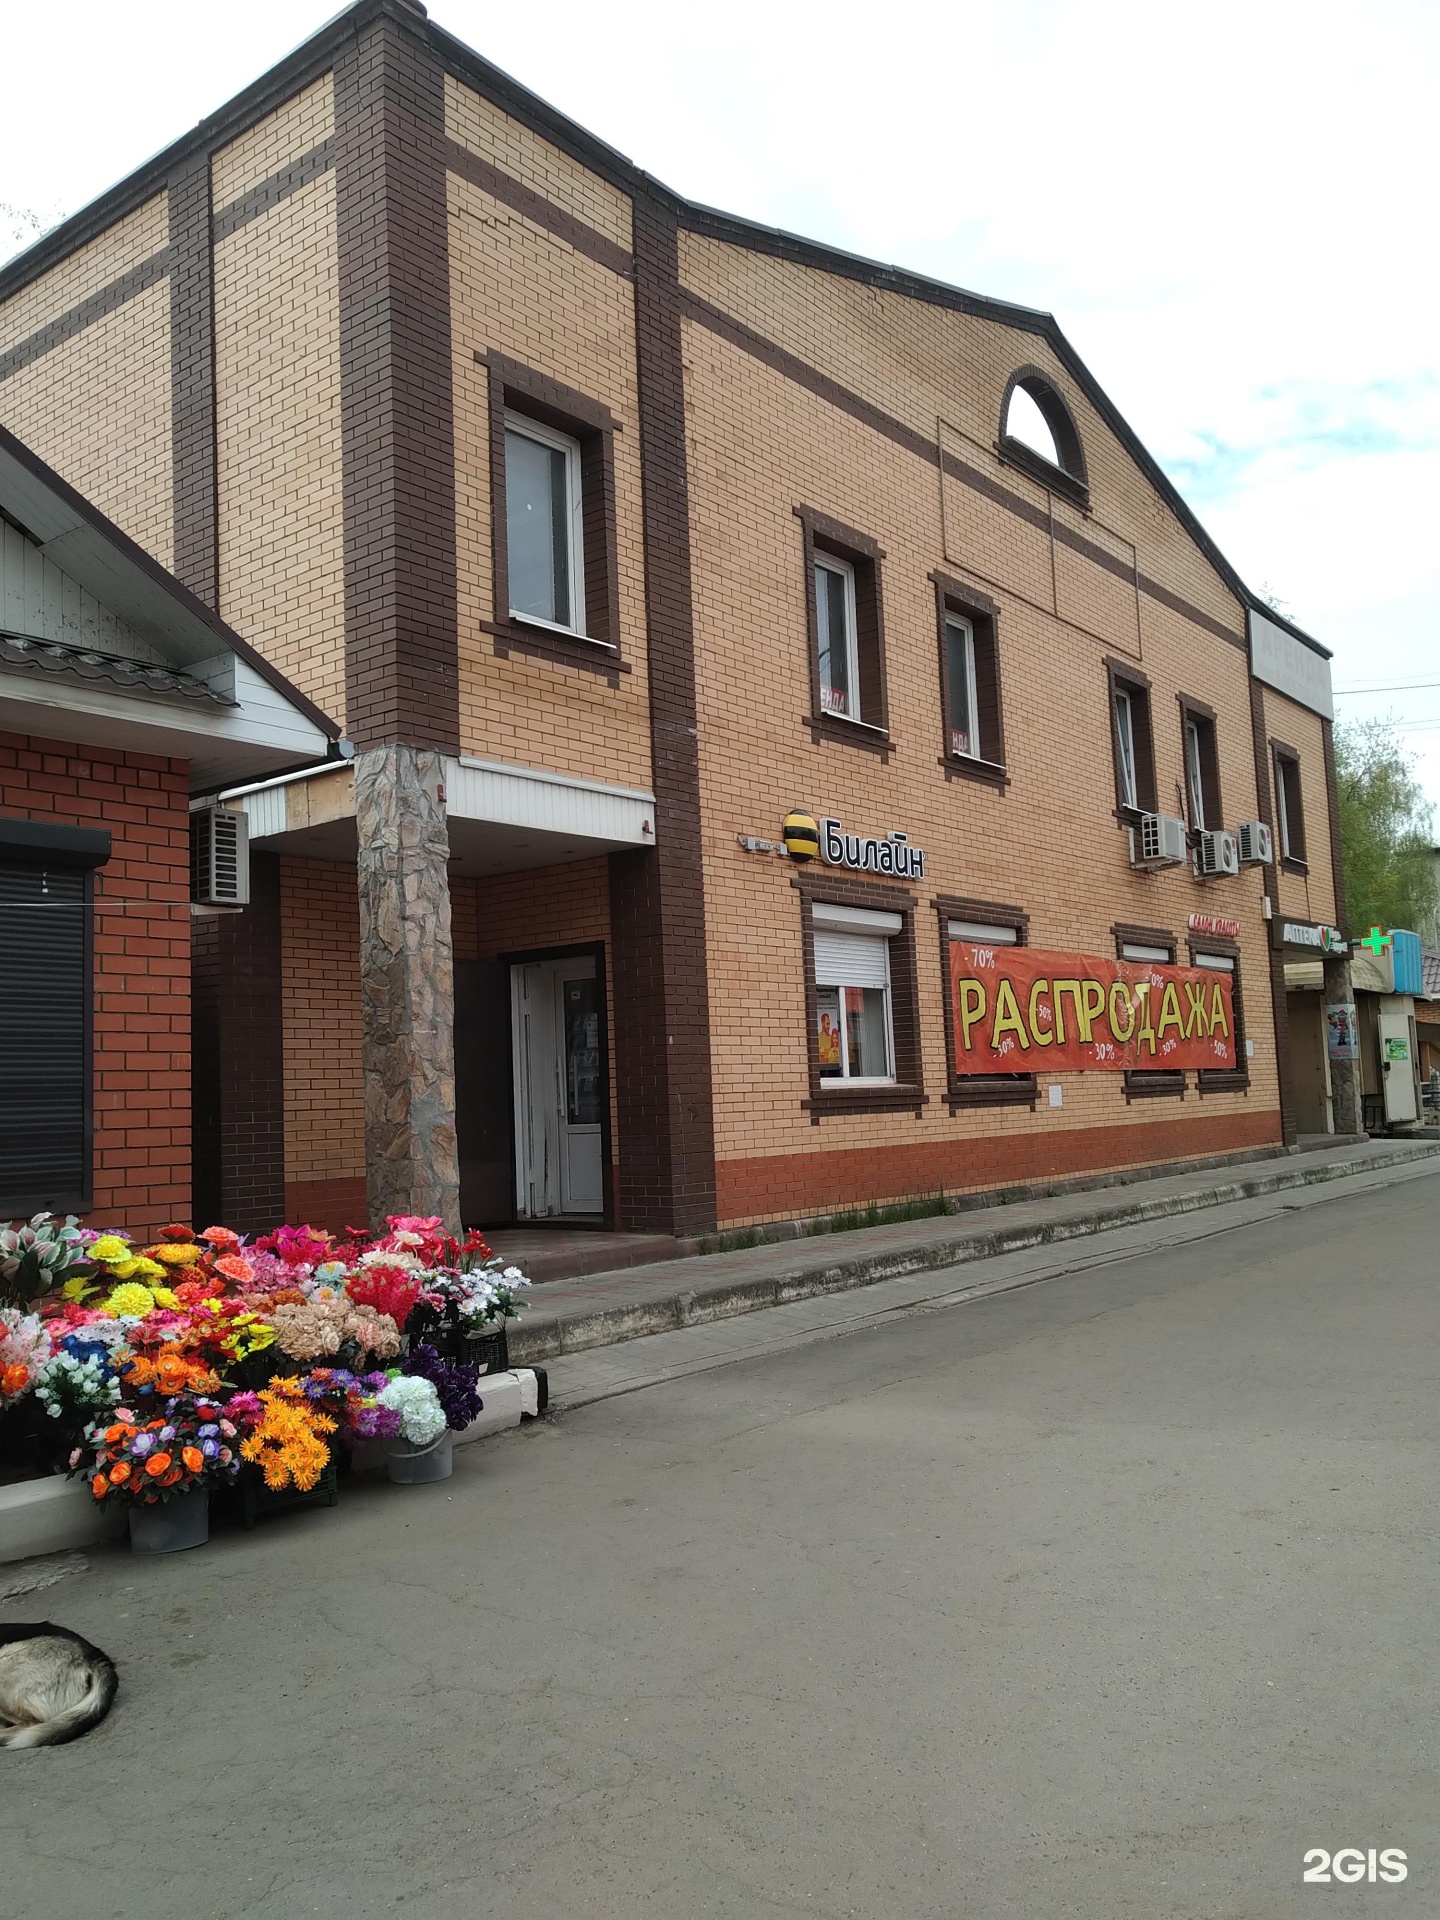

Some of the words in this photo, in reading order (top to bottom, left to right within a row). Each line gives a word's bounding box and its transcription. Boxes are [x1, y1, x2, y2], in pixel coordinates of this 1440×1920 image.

[821, 687, 845, 713] ЕНДА
[822, 818, 925, 879] Билайн
[959, 977, 1229, 1056] РАСПРОДАЖА
